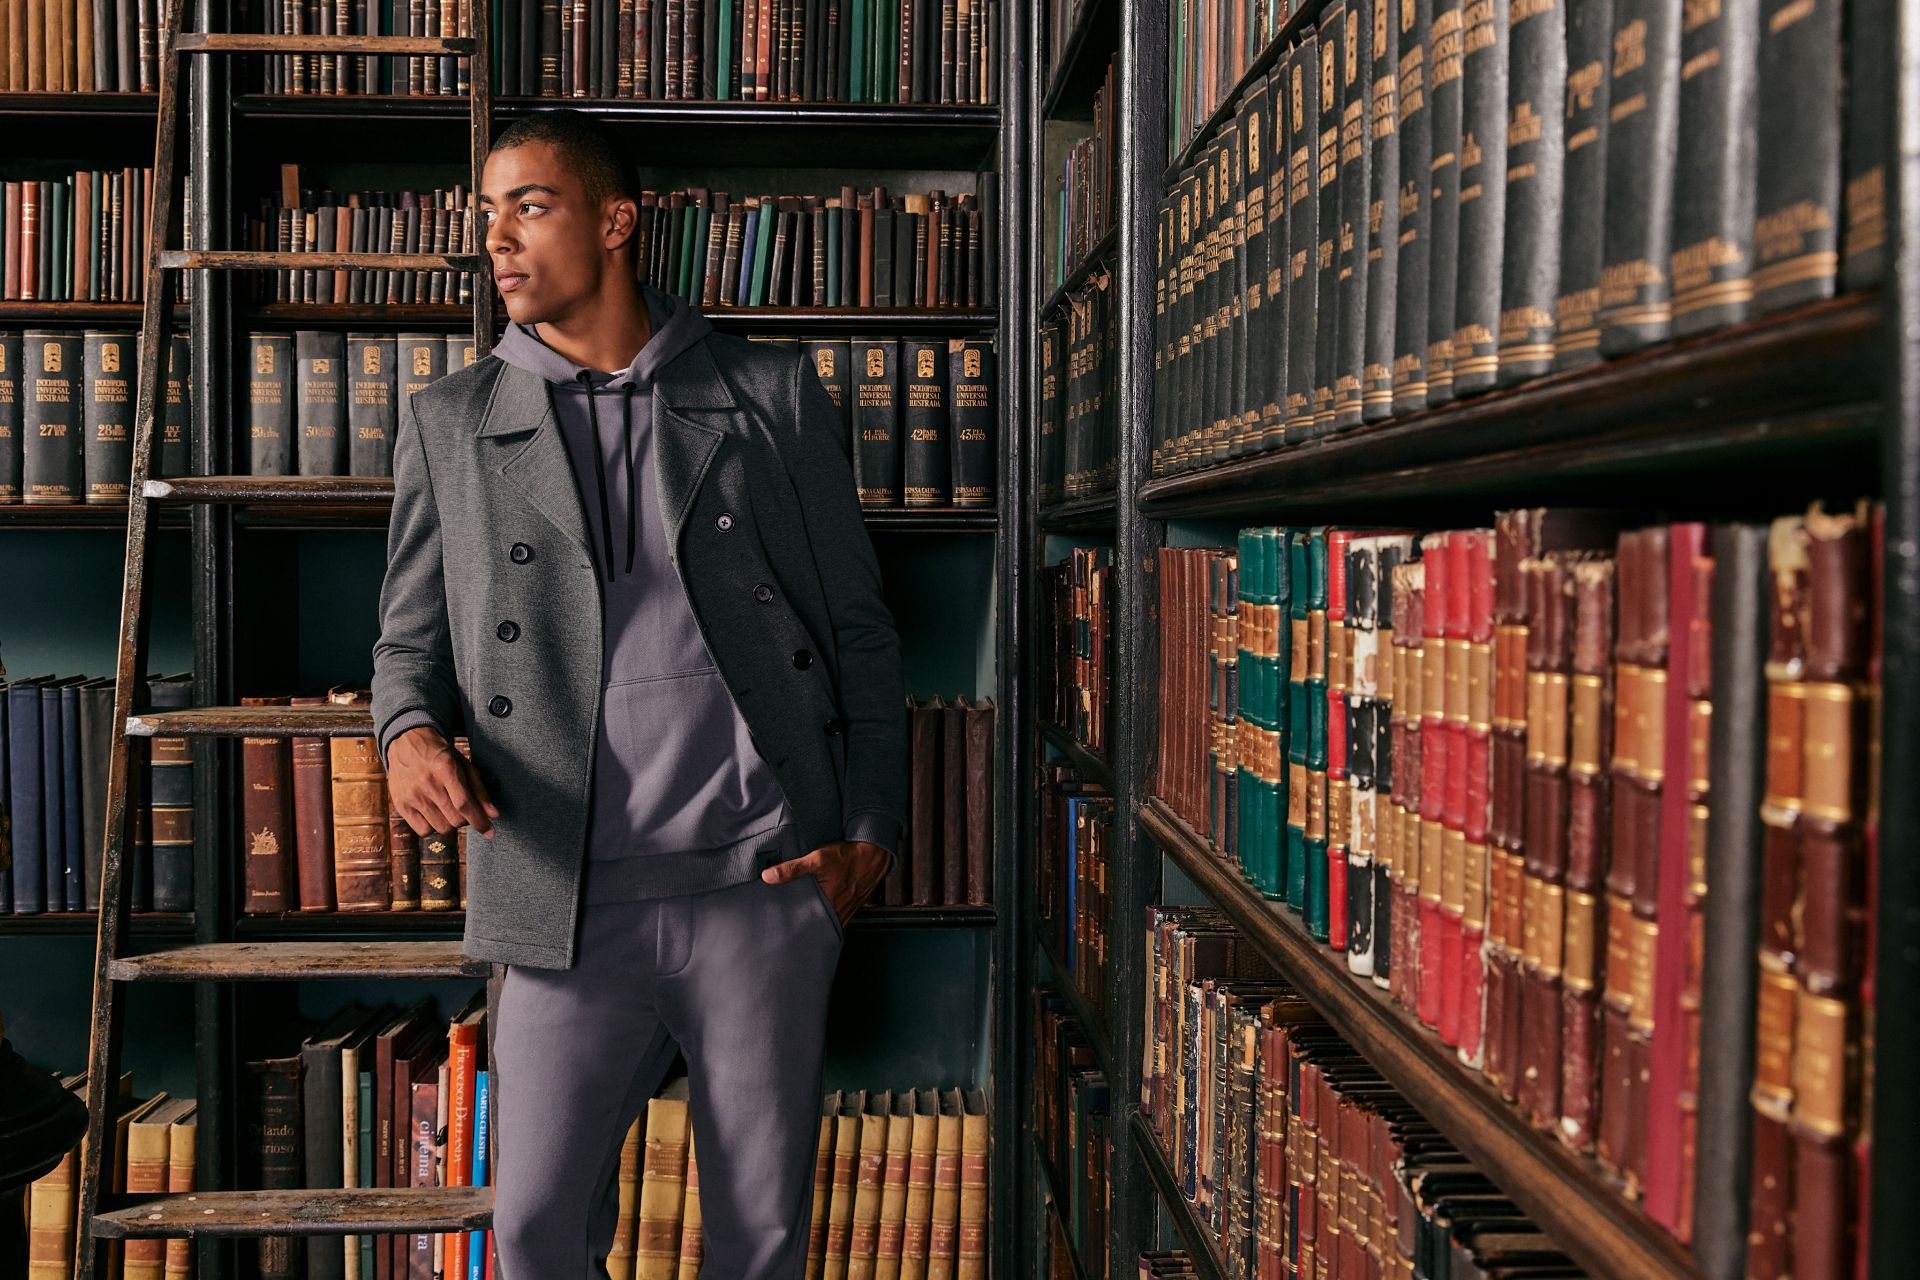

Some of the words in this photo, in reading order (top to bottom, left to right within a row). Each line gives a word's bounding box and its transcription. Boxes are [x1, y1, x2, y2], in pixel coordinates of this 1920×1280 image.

[860, 384, 892, 392] ENCICLOPEDIA
[909, 384, 941, 392] ENCICLOPEDIA
[956, 384, 988, 392] ENCICLOPEDIA
[36, 394, 70, 402] ILUSTRADA
[40, 424, 54, 437] 27
[97, 424, 112, 436] 28
[911, 429, 922, 440] 42
[960, 429, 972, 440] 43
[456, 1048, 469, 1105] FRANCISCO
[480, 1088, 488, 1120] CARTAS
[249, 1124, 294, 1136] Orlando
[478, 1120, 486, 1160] CELESTES
[252, 1142, 294, 1154] urioso
[418, 1120, 434, 1176] cinema
